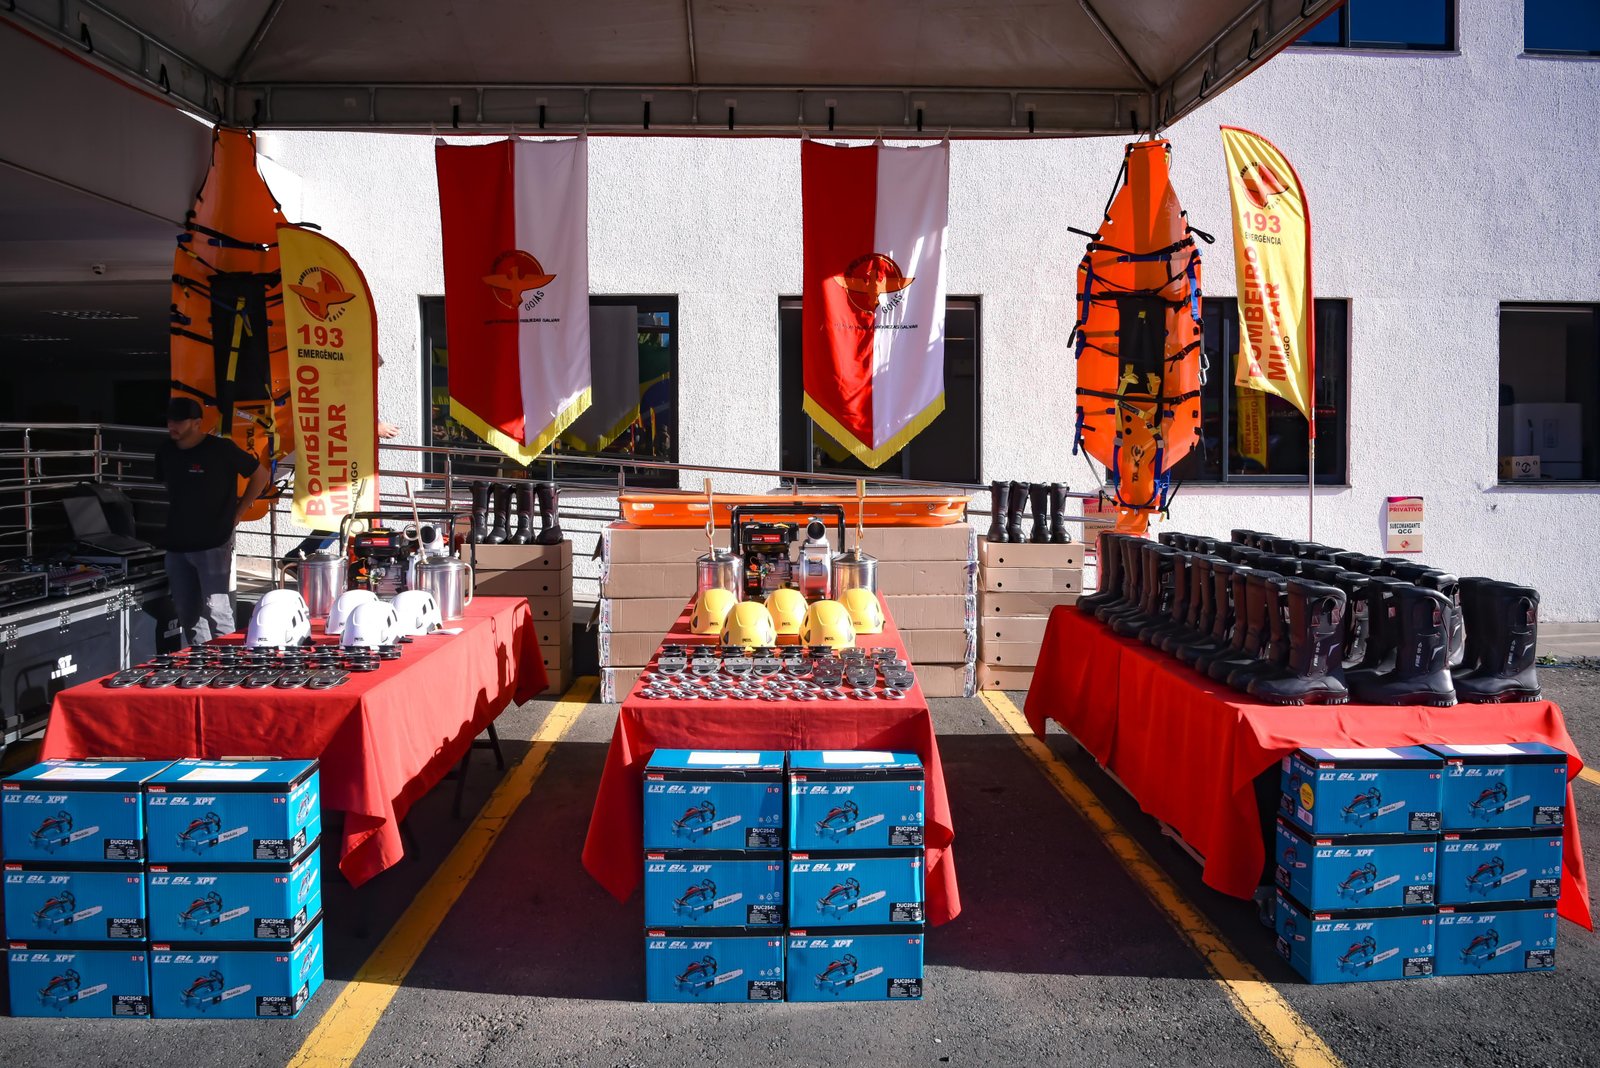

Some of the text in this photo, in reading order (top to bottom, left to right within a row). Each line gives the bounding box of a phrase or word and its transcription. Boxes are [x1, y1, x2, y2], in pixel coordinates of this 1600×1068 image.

[1243, 211, 1281, 233] 193
[297, 324, 344, 348] 193
[298, 349, 344, 361] EMERGÊNCIA
[296, 364, 326, 516] BOMBEIRO
[327, 404, 349, 516] MILITAR
[1319, 773, 1334, 781] LXT
[1359, 773, 1378, 781] XPT
[1485, 768, 1504, 777] XPT
[648, 785, 665, 793] LXT
[691, 786, 711, 794] XPT
[833, 786, 854, 794] XPT
[4, 795, 20, 803] LXT
[45, 795, 68, 804] XPT
[149, 797, 166, 805] LXT
[193, 797, 215, 806] XPT
[1445, 844, 1460, 852] LXT
[1483, 843, 1501, 851] XPT
[1317, 849, 1331, 858] LXT
[1355, 849, 1374, 857] XPT
[690, 865, 712, 873] XPT
[792, 864, 811, 872] LXT
[835, 864, 856, 872] XPT
[49, 876, 70, 884] XPT
[151, 877, 169, 885] LXT
[195, 876, 217, 885] XPT
[1439, 916, 1454, 924] LXT
[1478, 915, 1496, 924] XPT
[1315, 923, 1330, 932] LXT
[1354, 923, 1373, 931] XPT
[650, 941, 667, 949] LXT
[790, 940, 807, 948] LXT
[833, 940, 853, 948] XPT
[11, 954, 29, 962] LXT
[54, 954, 76, 963] XPT
[154, 955, 171, 963] LXT
[198, 955, 219, 964] XPT
